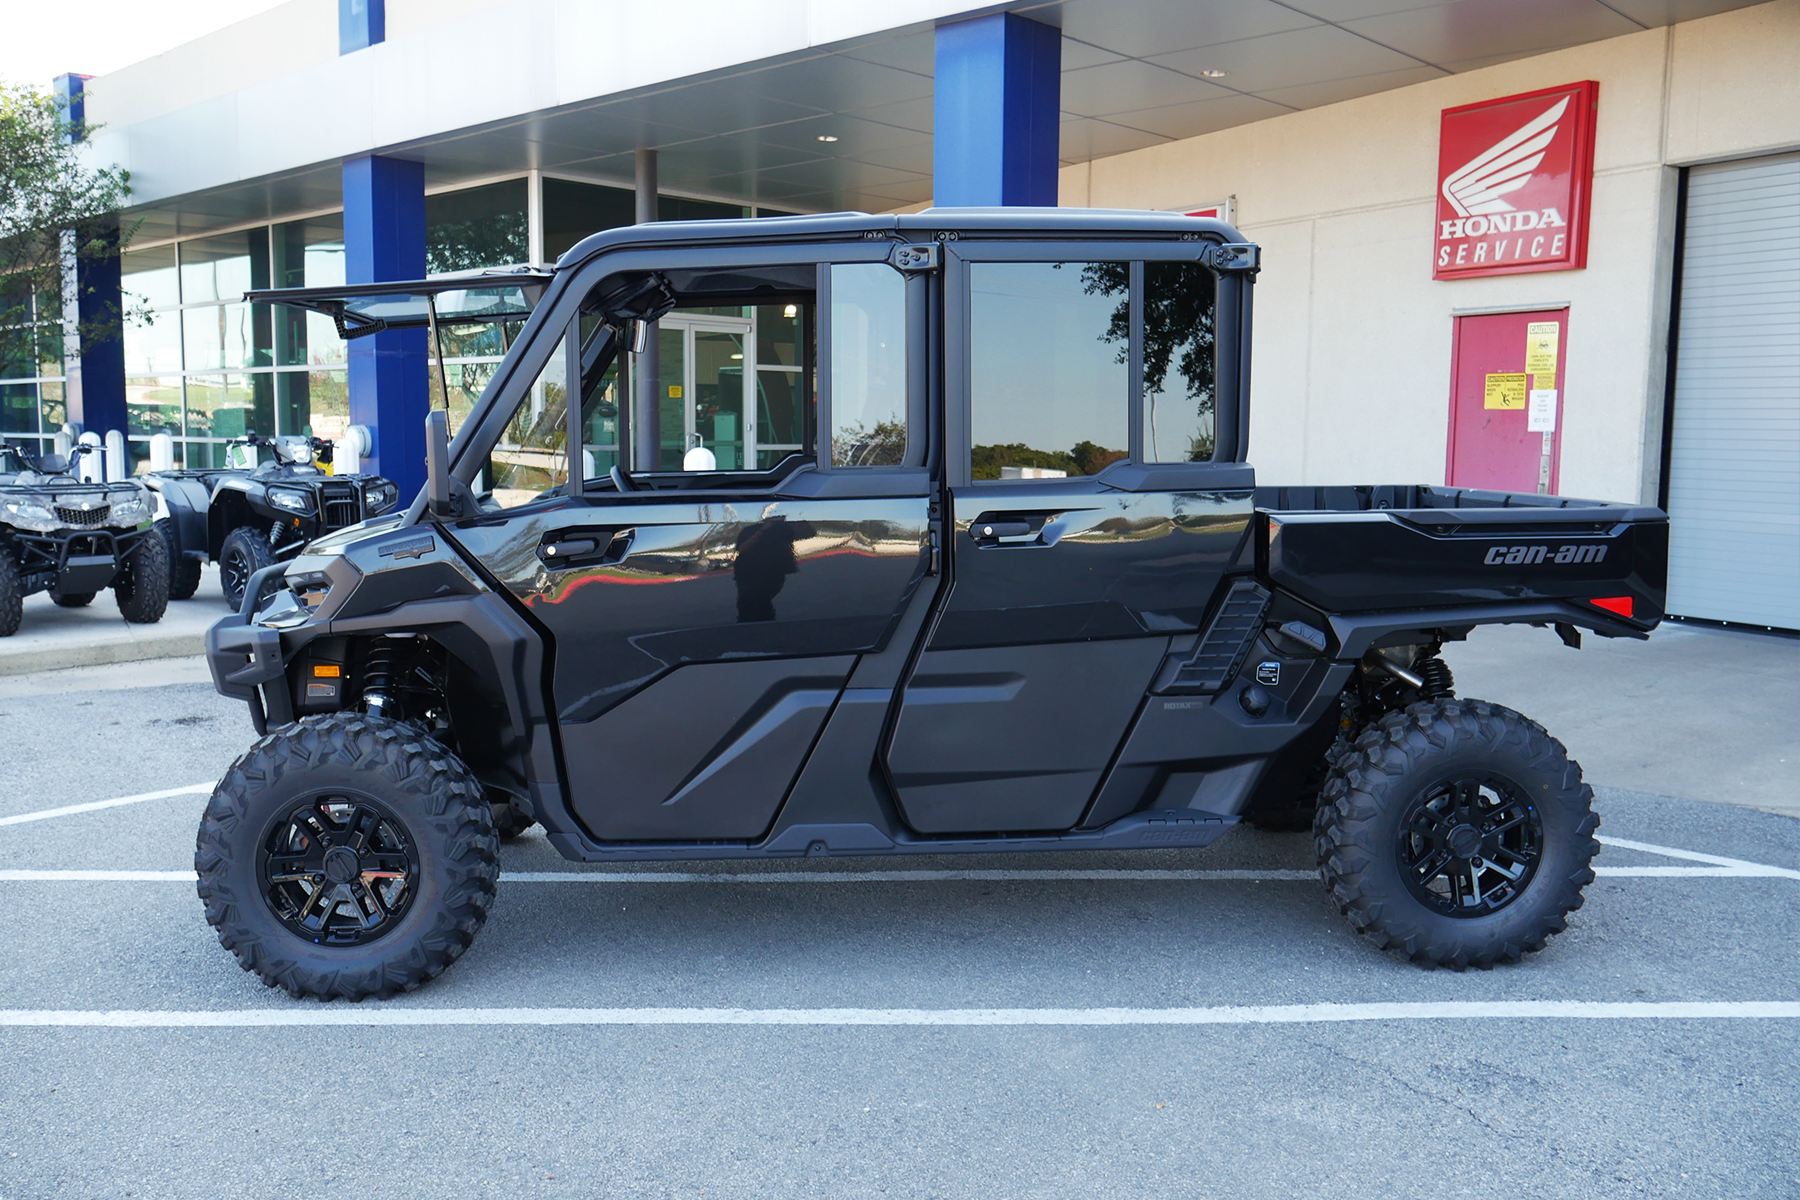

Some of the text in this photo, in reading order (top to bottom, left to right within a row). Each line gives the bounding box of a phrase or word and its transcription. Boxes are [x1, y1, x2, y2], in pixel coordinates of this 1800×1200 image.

[1440, 207, 1566, 240] HONDA
[1438, 233, 1566, 266] SERVICE
[1530, 325, 1557, 334] CAUTION
[378, 536, 431, 554] DEFENDER
[1483, 544, 1608, 565] can-am
[1164, 702, 1191, 710] ROTAX
[1138, 829, 1211, 843] can-am
